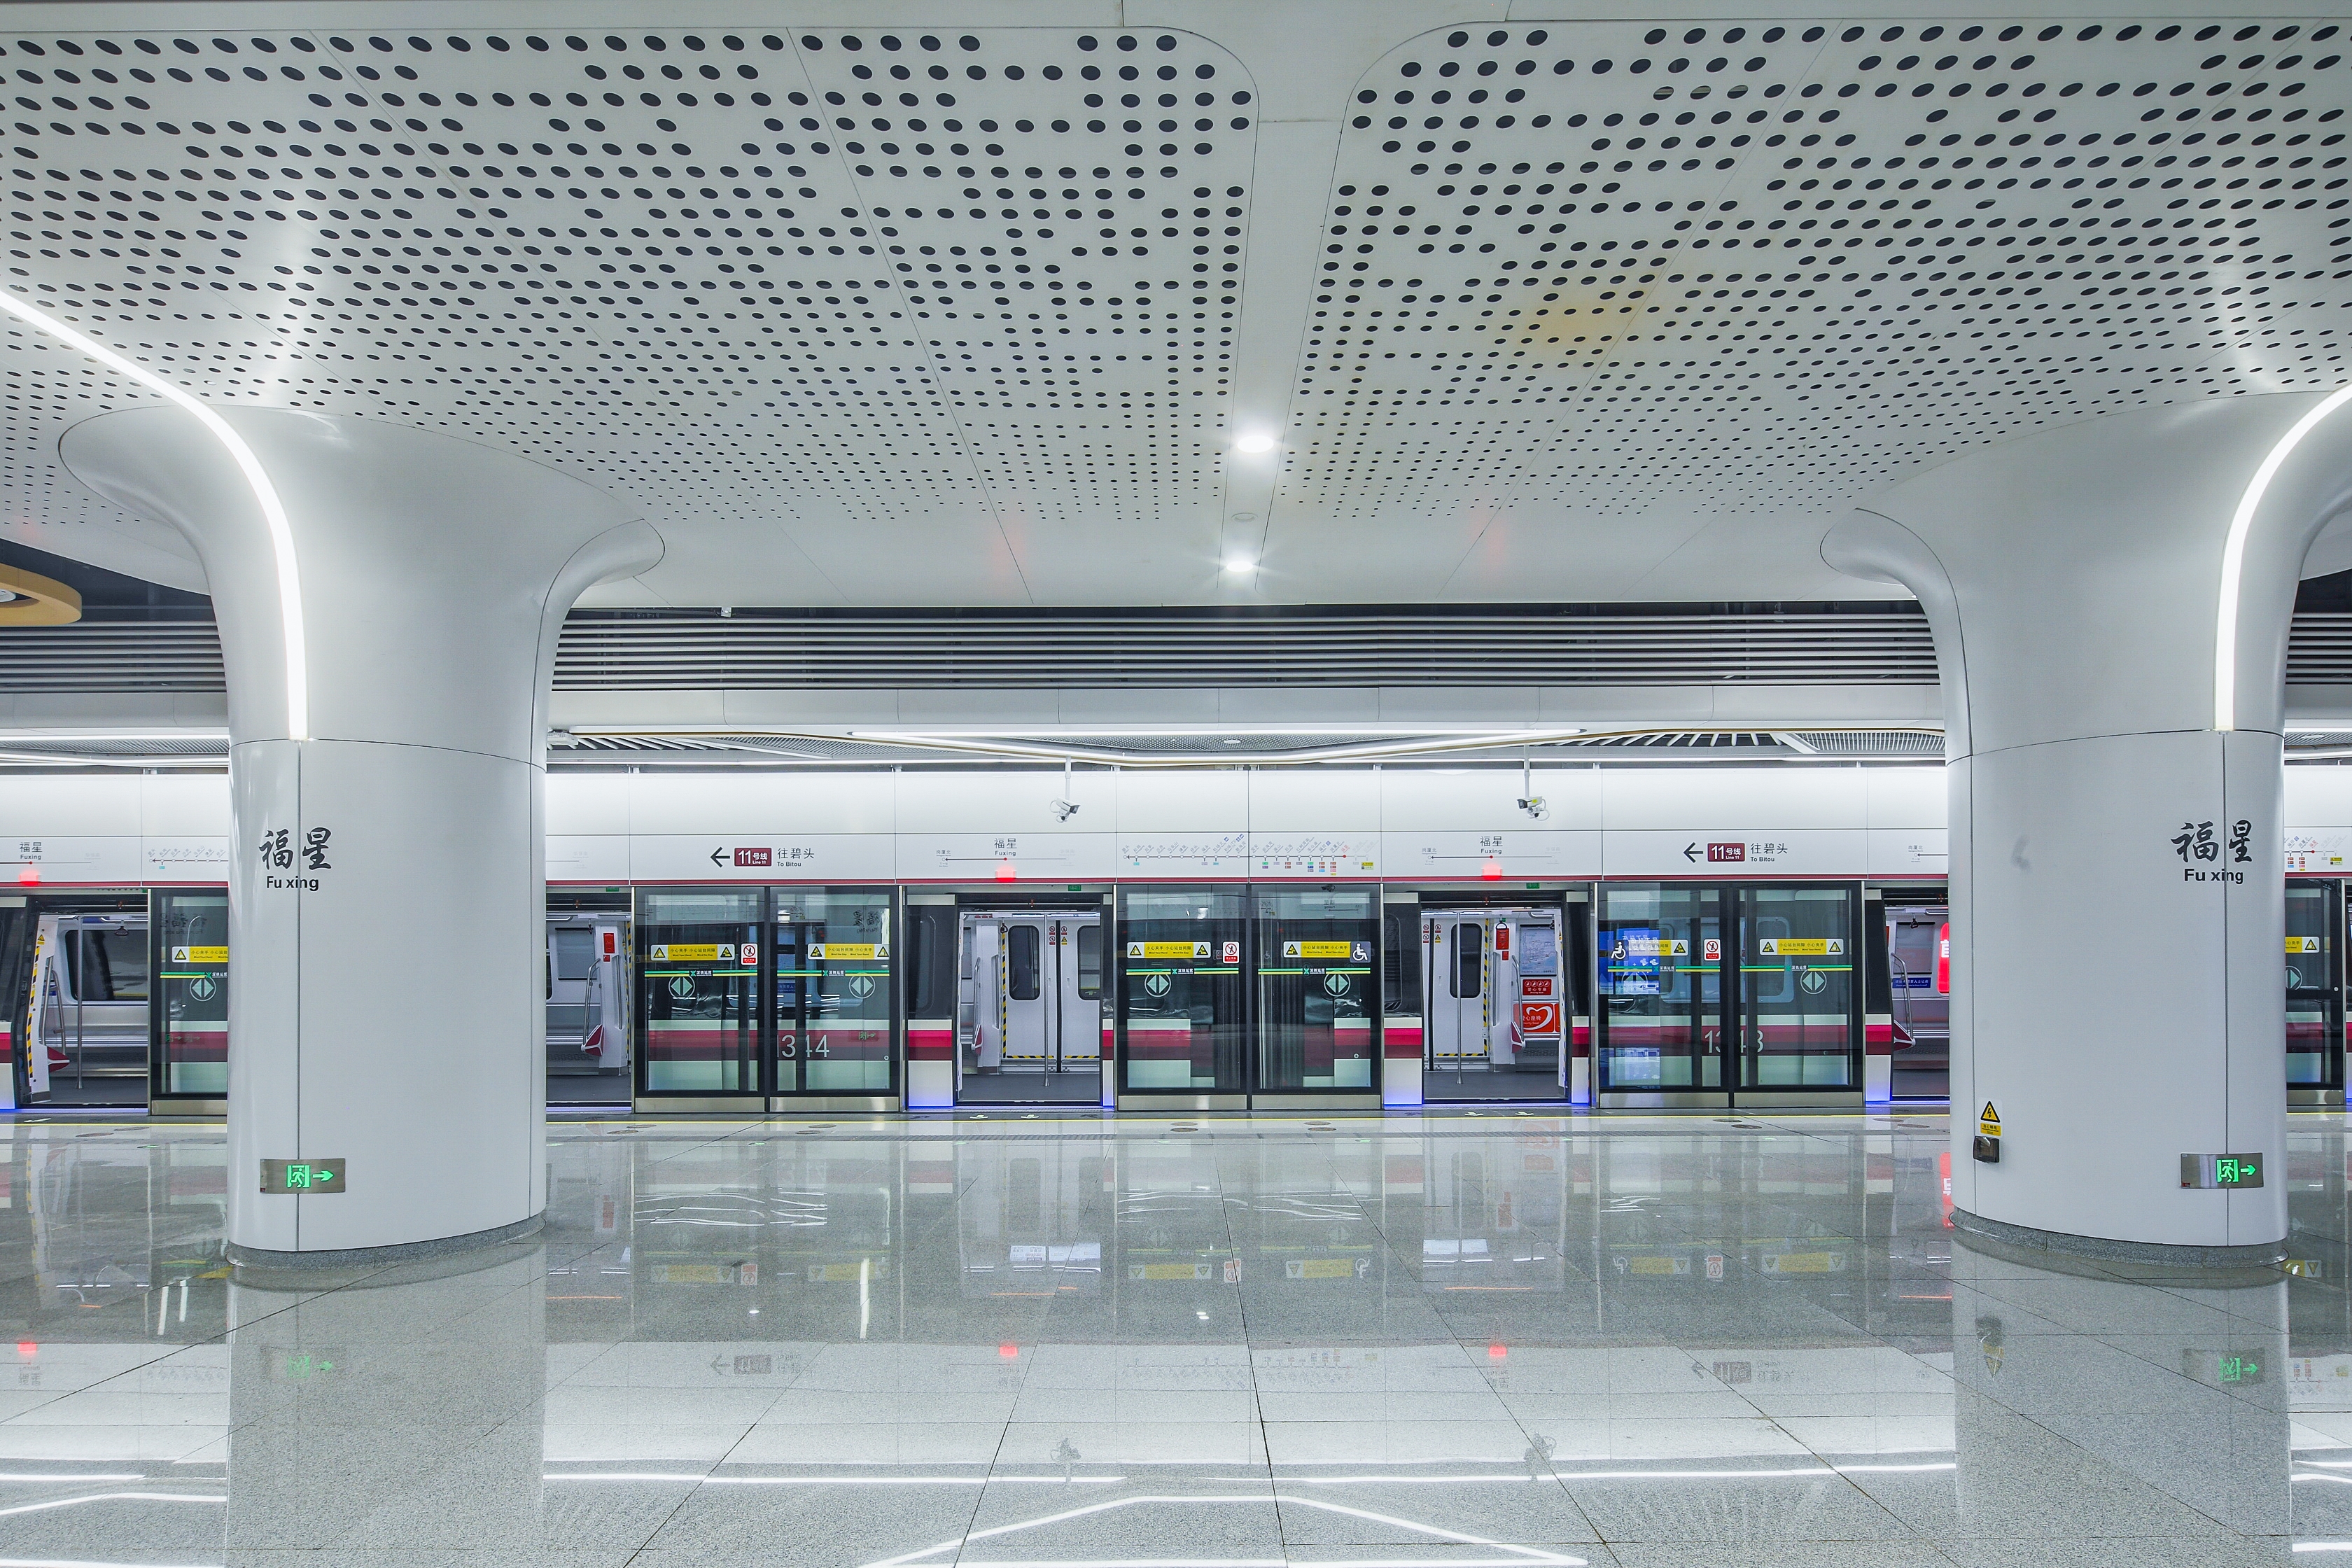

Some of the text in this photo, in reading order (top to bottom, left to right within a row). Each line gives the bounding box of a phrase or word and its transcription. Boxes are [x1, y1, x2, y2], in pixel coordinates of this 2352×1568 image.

[19, 841, 43, 853] 福星
[258, 827, 332, 870] 福星
[994, 838, 1017, 849] 福星
[1480, 836, 1503, 847] 福星
[1750, 843, 1788, 854] 往碧头
[2170, 820, 2252, 863] 福星
[738, 849, 769, 864] 11号线
[777, 848, 815, 860] 往碧头
[1711, 845, 1742, 860] 11号线
[267, 875, 319, 892] Fu xing
[2184, 868, 2244, 885] Fu xing
